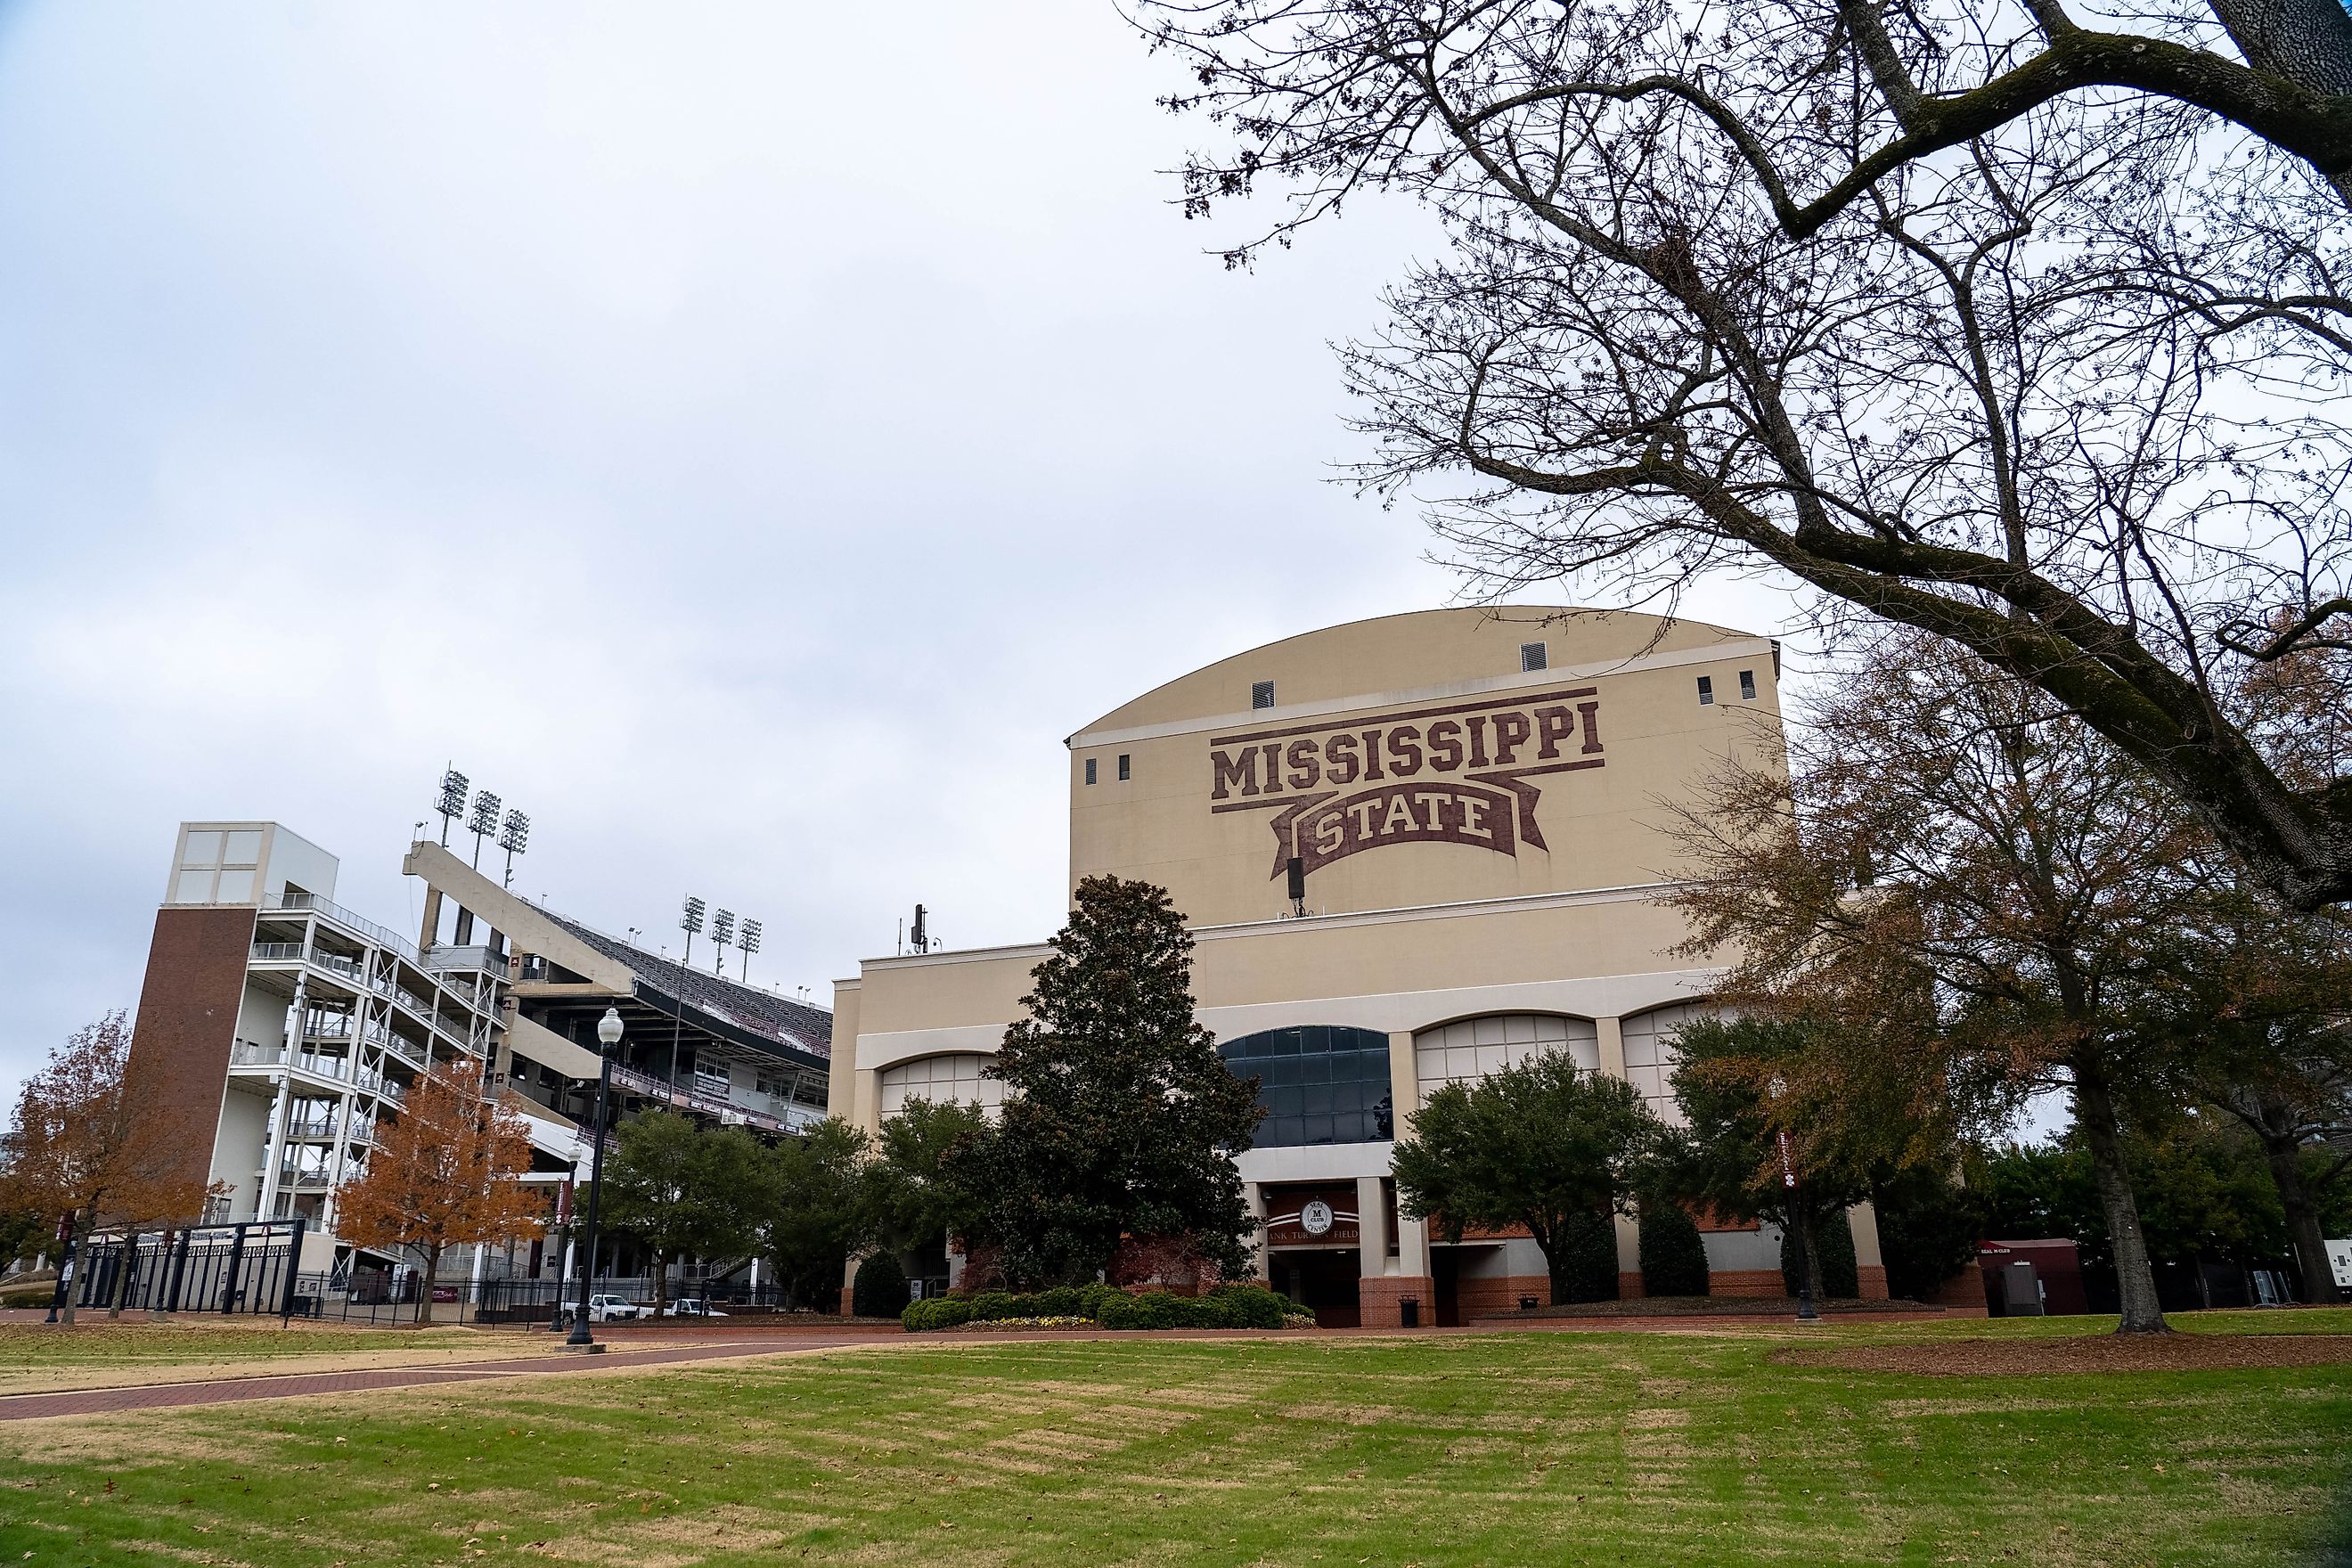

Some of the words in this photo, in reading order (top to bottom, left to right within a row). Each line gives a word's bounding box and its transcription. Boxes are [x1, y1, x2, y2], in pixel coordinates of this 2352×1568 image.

[1211, 701, 1605, 800] MISSISSIPPI
[1316, 792, 1492, 855] STATE
[1312, 1209, 1322, 1218] M
[1307, 1223, 1328, 1232] CENTER
[1292, 1231, 1329, 1239] TURMN
[1334, 1230, 1358, 1238] FIELD
